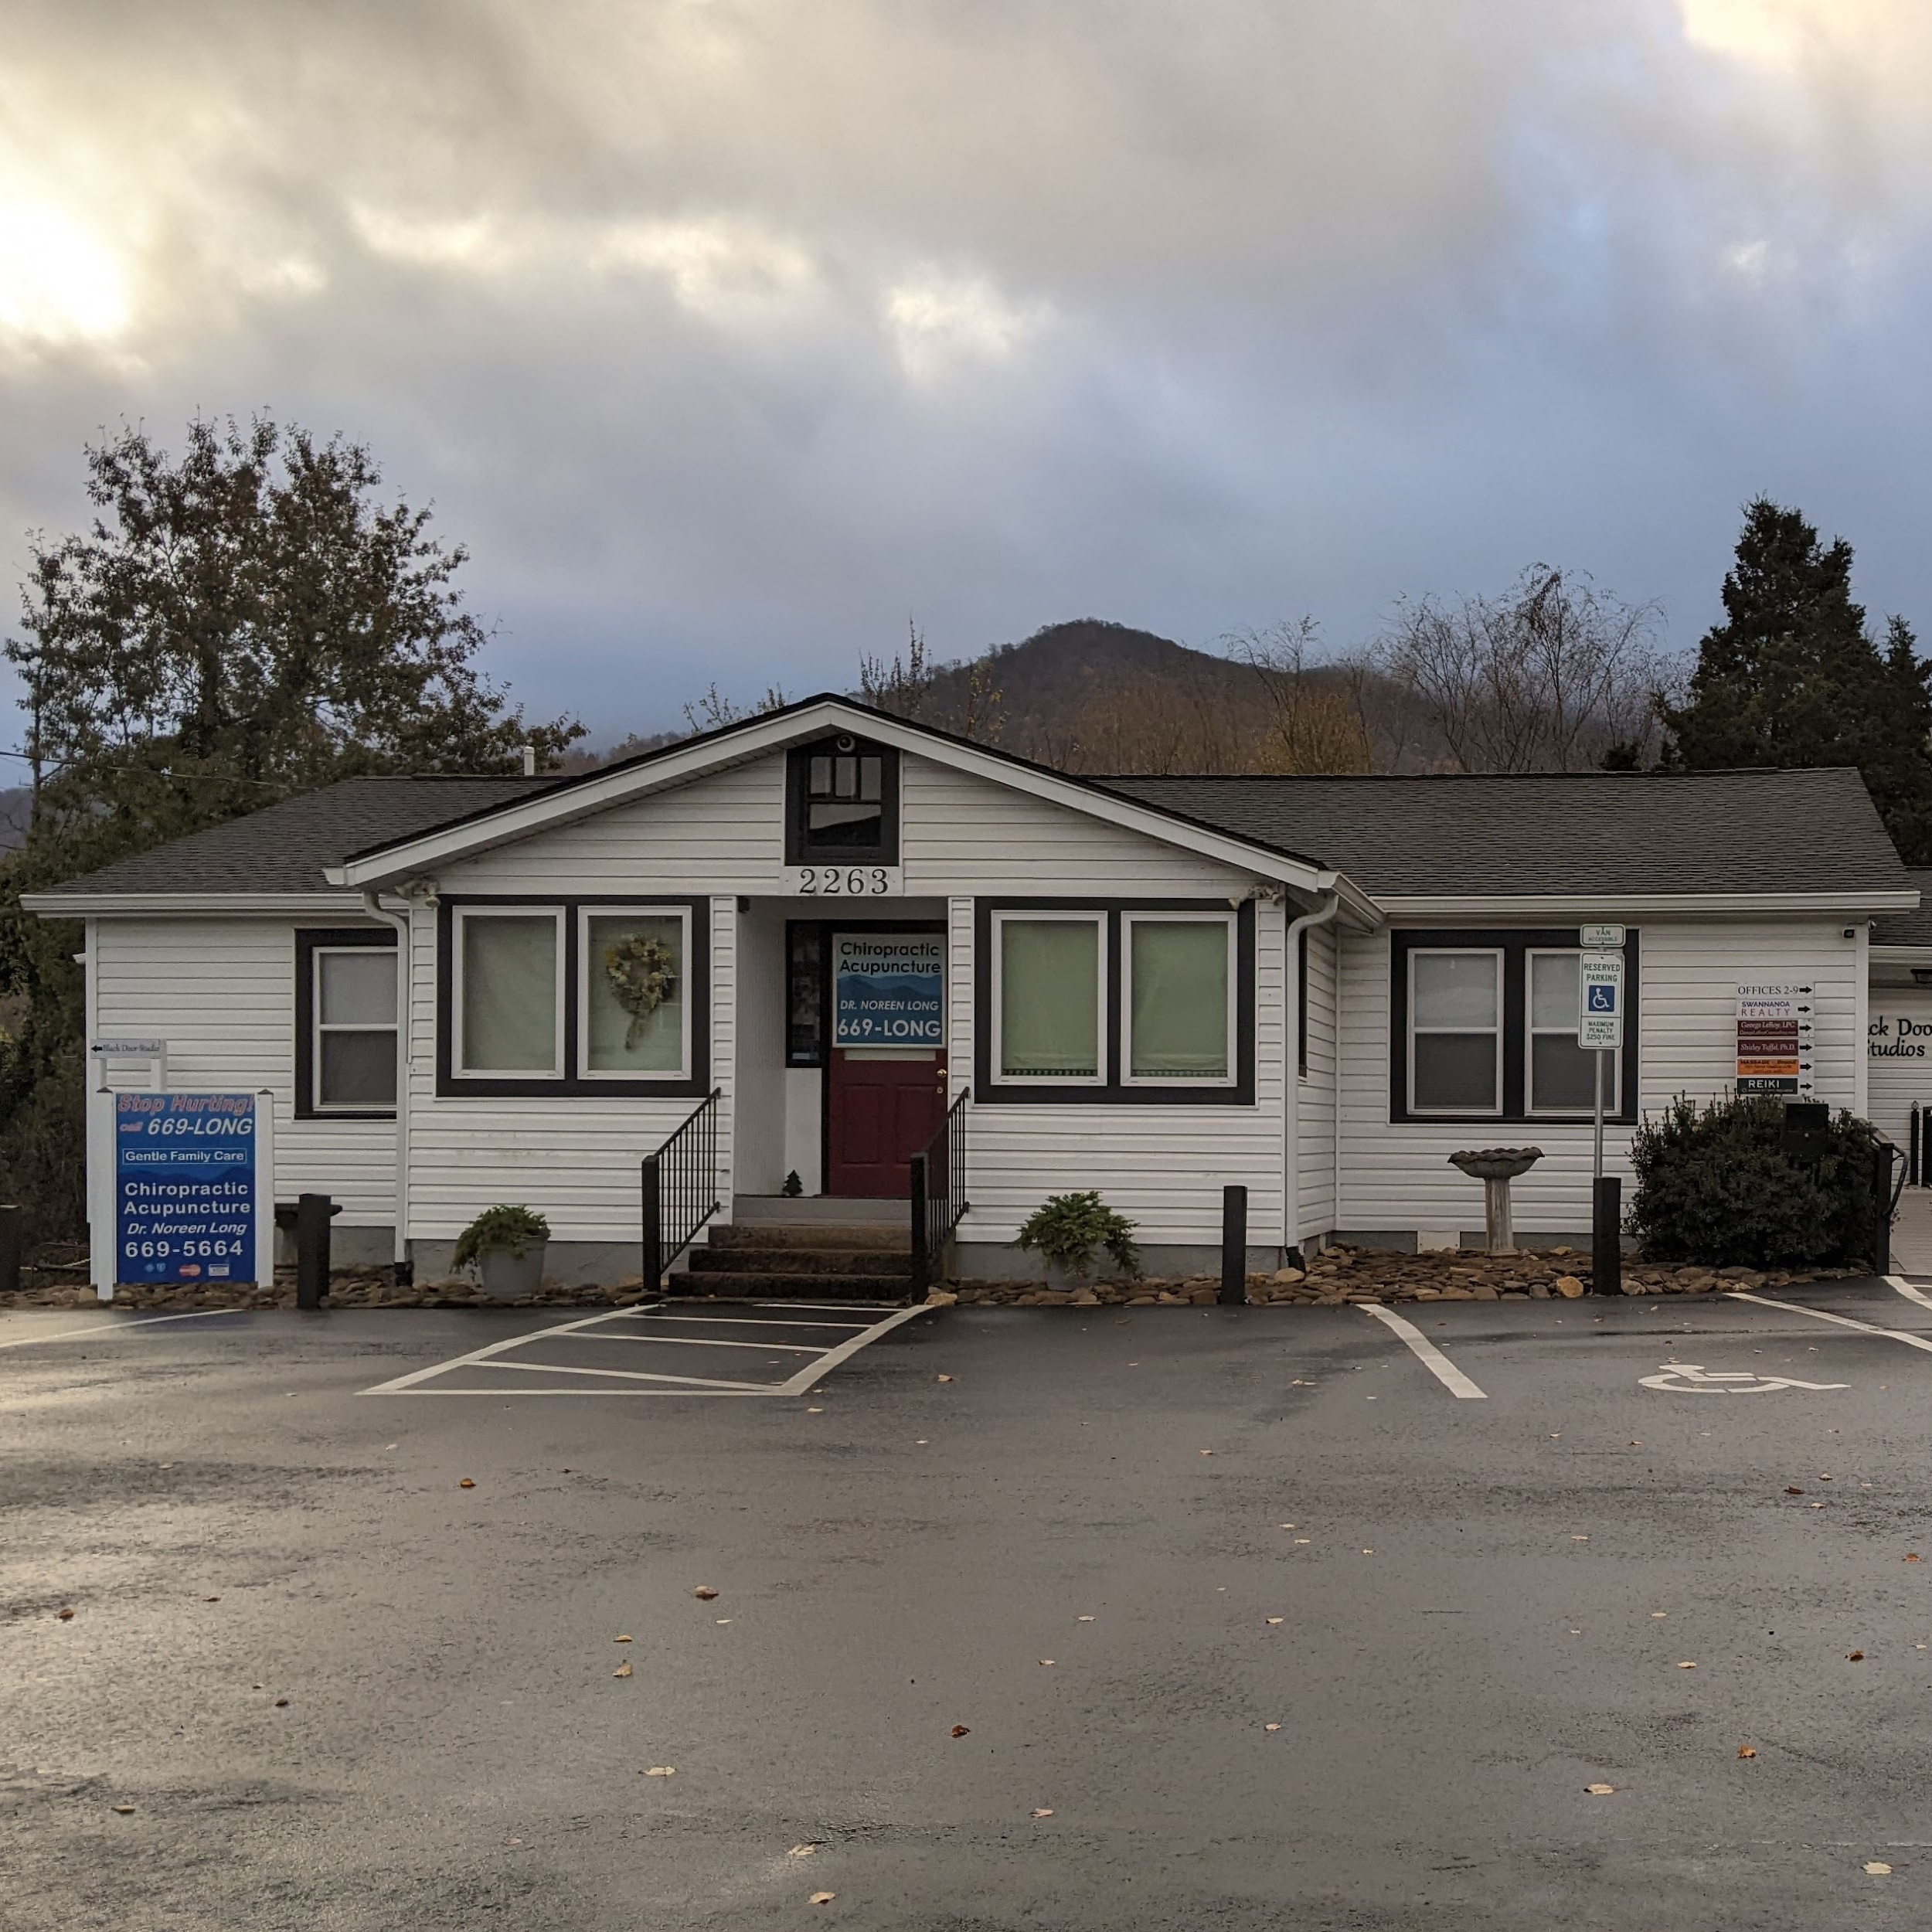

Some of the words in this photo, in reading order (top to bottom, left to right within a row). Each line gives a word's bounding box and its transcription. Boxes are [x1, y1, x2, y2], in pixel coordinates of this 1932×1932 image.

[799, 868, 889, 894] 2263
[840, 942, 940, 958] Chiropractic
[839, 959, 941, 975] Acupuncture
[1583, 963, 1621, 971] RESERVED
[1738, 986, 1781, 995] OFFICES
[1784, 986, 1798, 995] 2-9
[839, 1000, 857, 1010] DR.
[861, 1000, 904, 1011] NOREEN
[907, 1001, 939, 1011] LONG
[838, 1019, 941, 1037] 669-LONG
[1740, 1021, 1761, 1029] George
[1868, 1015, 1889, 1036] ck
[1868, 1036, 1925, 1057] tudios
[1748, 1080, 1780, 1088] REIKI
[117, 1094, 165, 1115] Stop
[170, 1094, 255, 1116] Hurting!
[119, 1121, 144, 1132] call
[148, 1117, 253, 1135] 669-LONG
[125, 1151, 167, 1161] Gentle
[170, 1151, 211, 1162] Family
[214, 1151, 244, 1161] Care
[124, 1182, 249, 1199] Chiropractic
[124, 1201, 250, 1217] Acupuncture
[127, 1223, 147, 1234] Dr.
[151, 1223, 207, 1234] Noreen
[209, 1222, 247, 1235] Long
[125, 1240, 243, 1257] 669-5664
